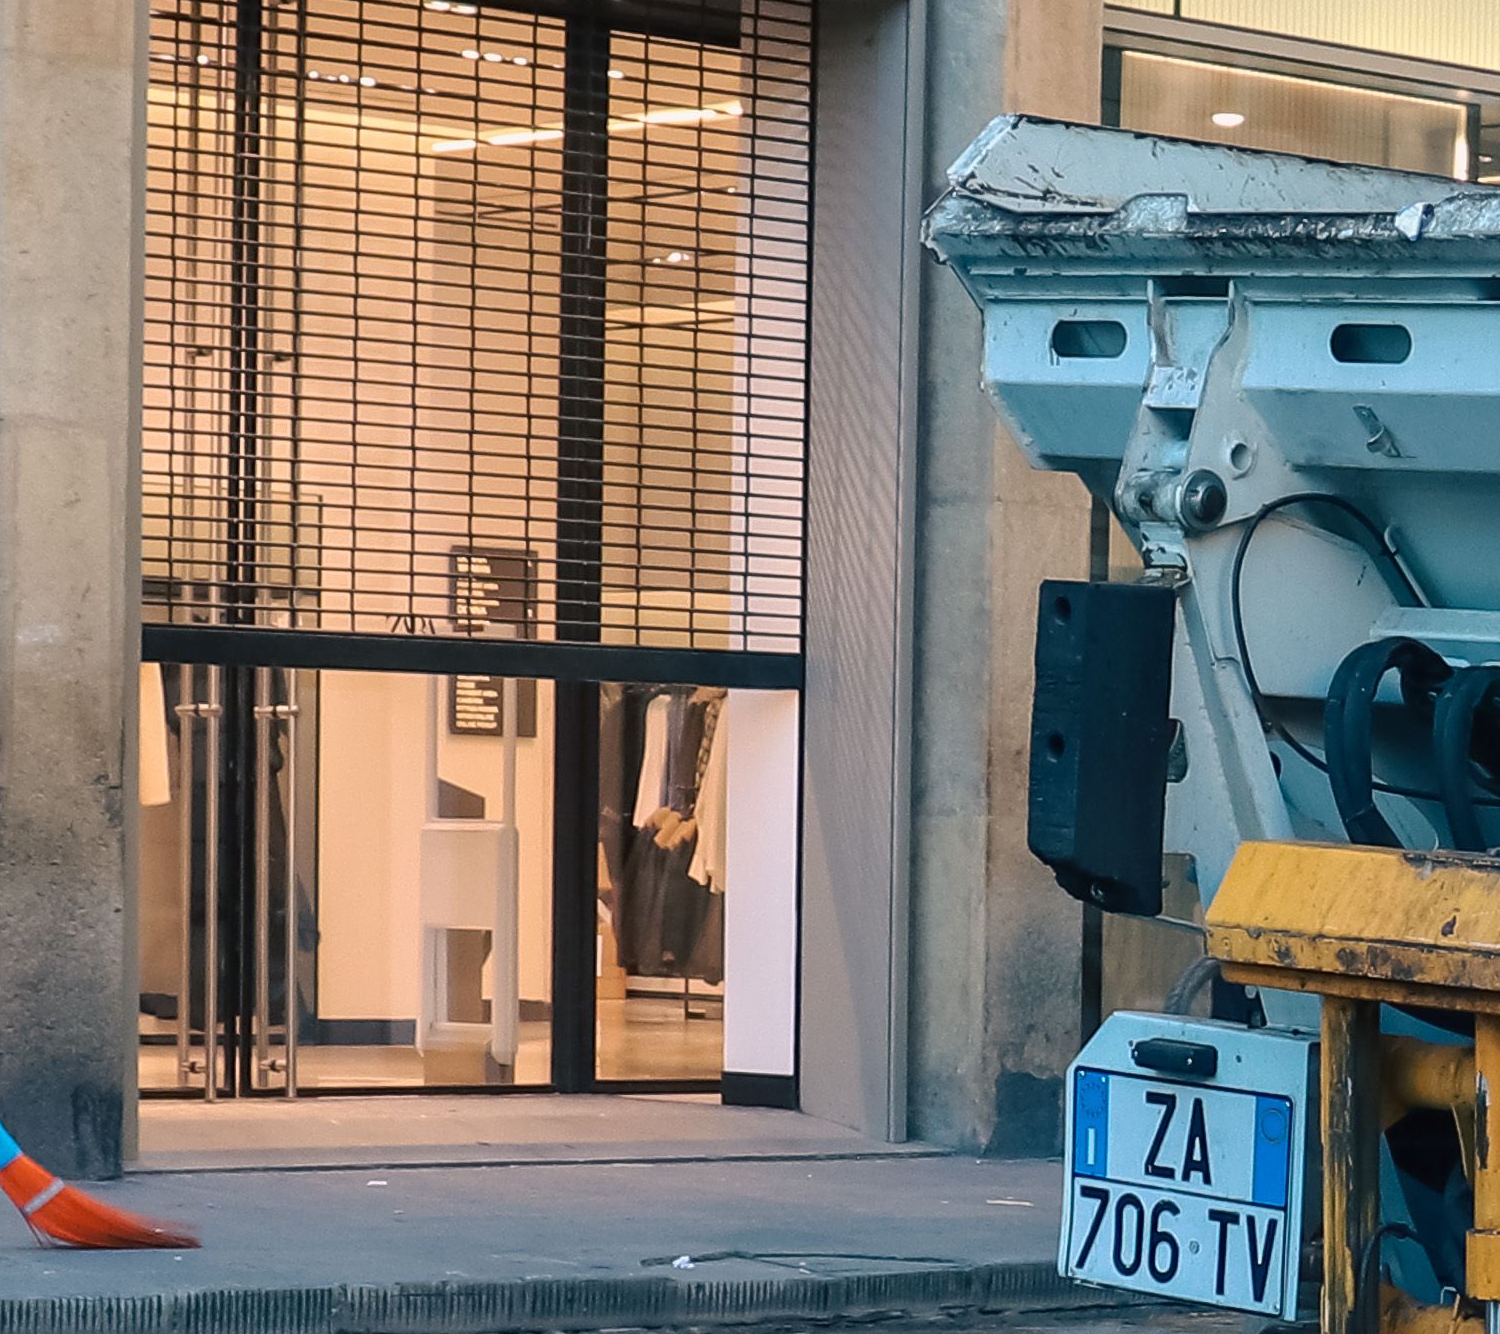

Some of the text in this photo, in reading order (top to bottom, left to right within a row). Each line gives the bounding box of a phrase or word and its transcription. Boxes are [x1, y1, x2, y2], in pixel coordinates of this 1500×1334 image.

[1144, 1090, 1213, 1186] ZA
[1075, 1184, 1279, 1303] 706 TV
